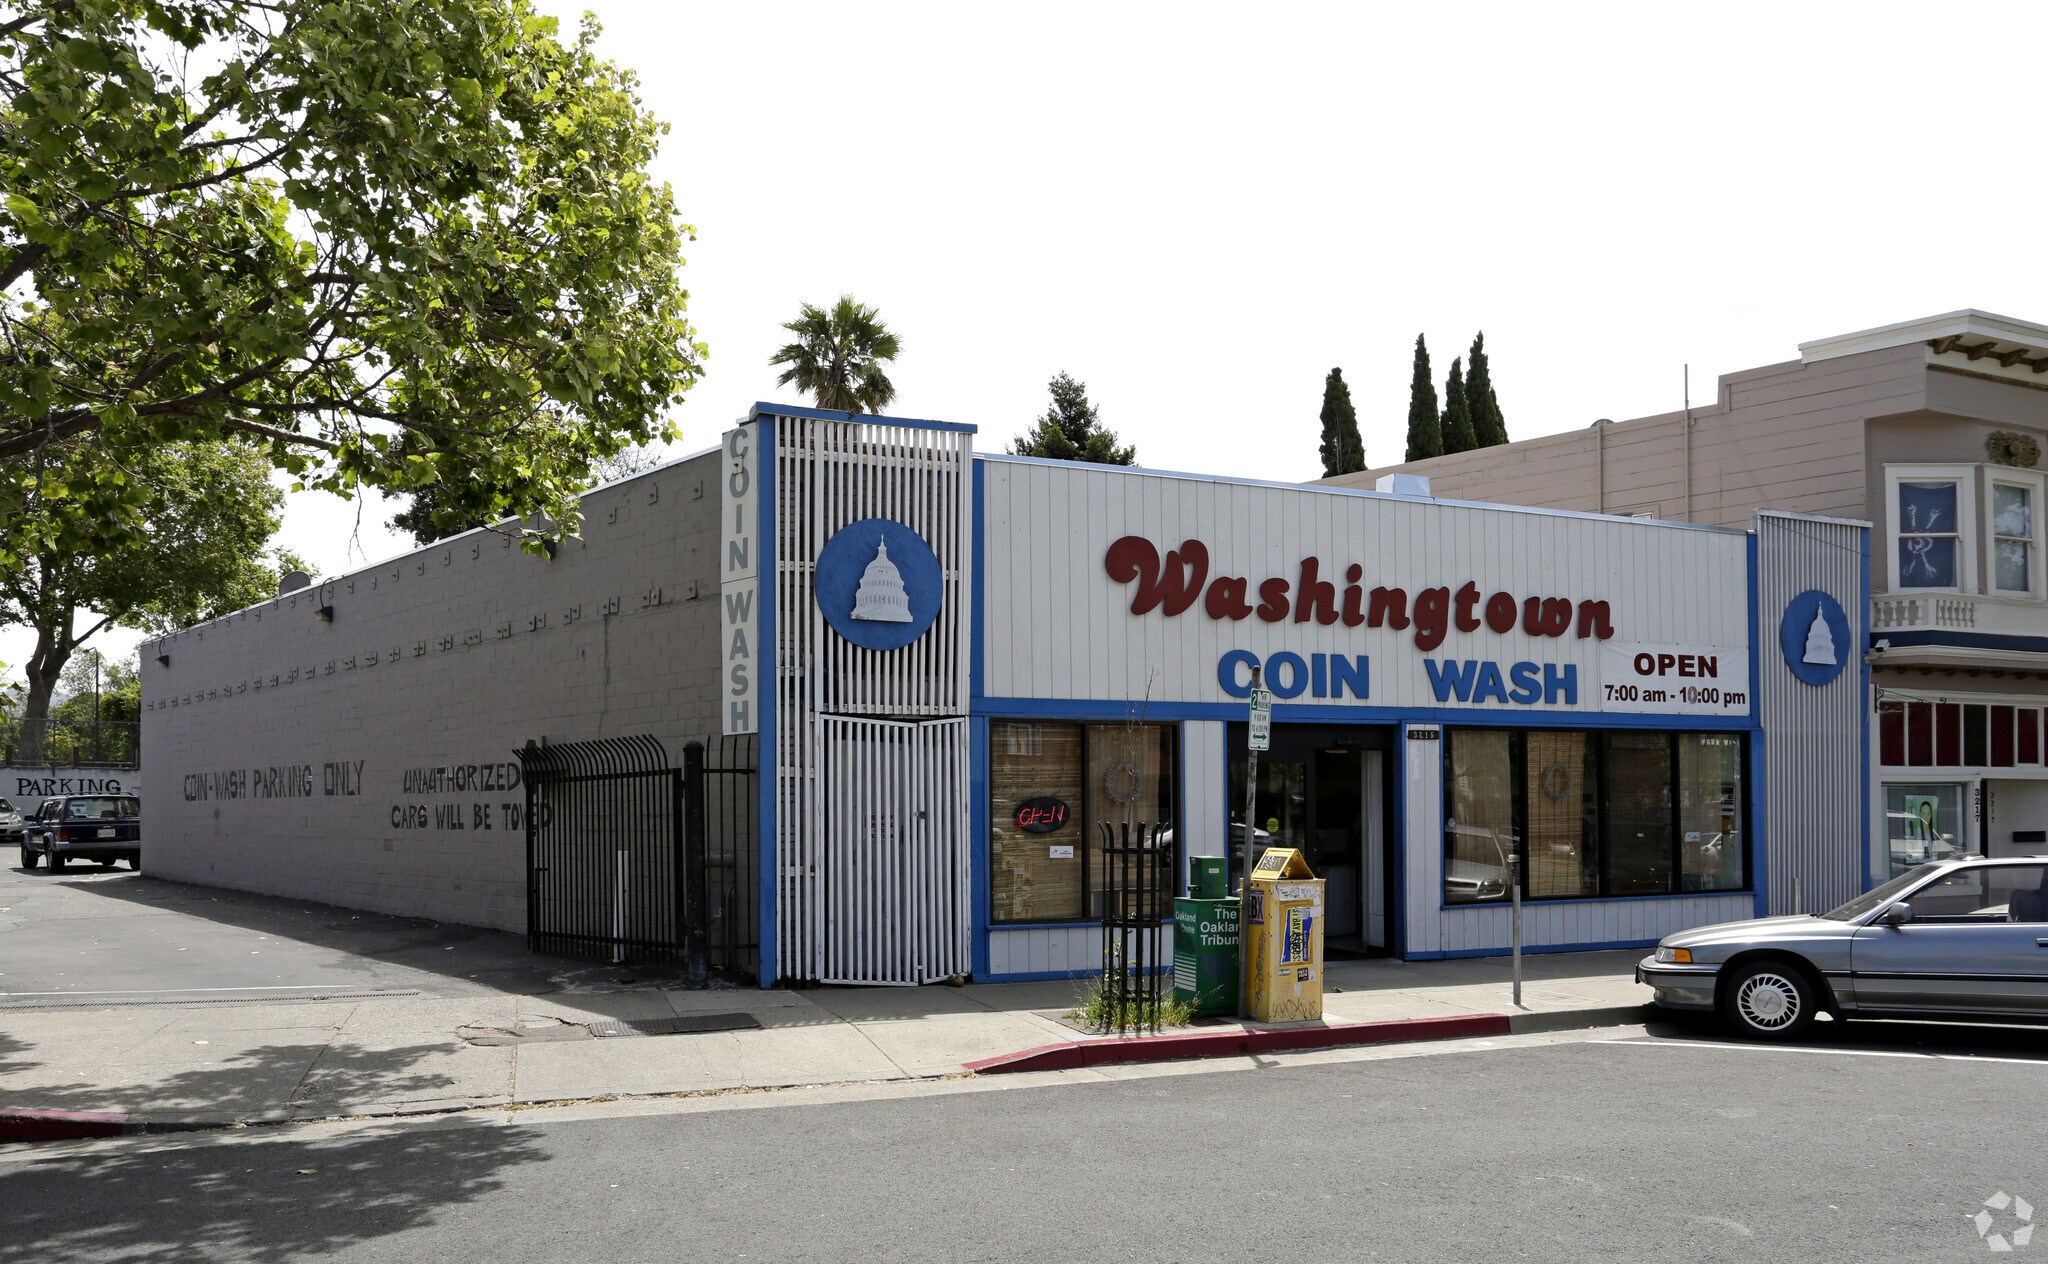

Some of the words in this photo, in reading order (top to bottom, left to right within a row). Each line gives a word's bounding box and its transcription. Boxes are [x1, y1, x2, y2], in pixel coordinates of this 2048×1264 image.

[729, 429, 750, 573] COIN
[1105, 535, 1615, 651] Washingtown
[725, 589, 754, 733] WASH
[1633, 652, 1718, 678] OPEN
[1217, 649, 1370, 700] COIN
[1423, 658, 1578, 705] WASH
[1252, 694, 1257, 709] 2
[1604, 684, 1638, 702] 7:00
[1642, 690, 1667, 703] am
[1679, 686, 1720, 705] 10:00
[1723, 692, 1746, 708] pm
[1413, 731, 1435, 739] 3215
[16, 778, 121, 796] PARKING
[253, 764, 312, 799] PARKING
[323, 760, 365, 796] ONLY
[403, 762, 520, 794] UNAUTHORIZED
[391, 804, 428, 829] CARS
[435, 803, 464, 830] WILL
[473, 803, 492, 831] BE
[1214, 908, 1237, 919] The
[1200, 934, 1239, 946] Tribun
